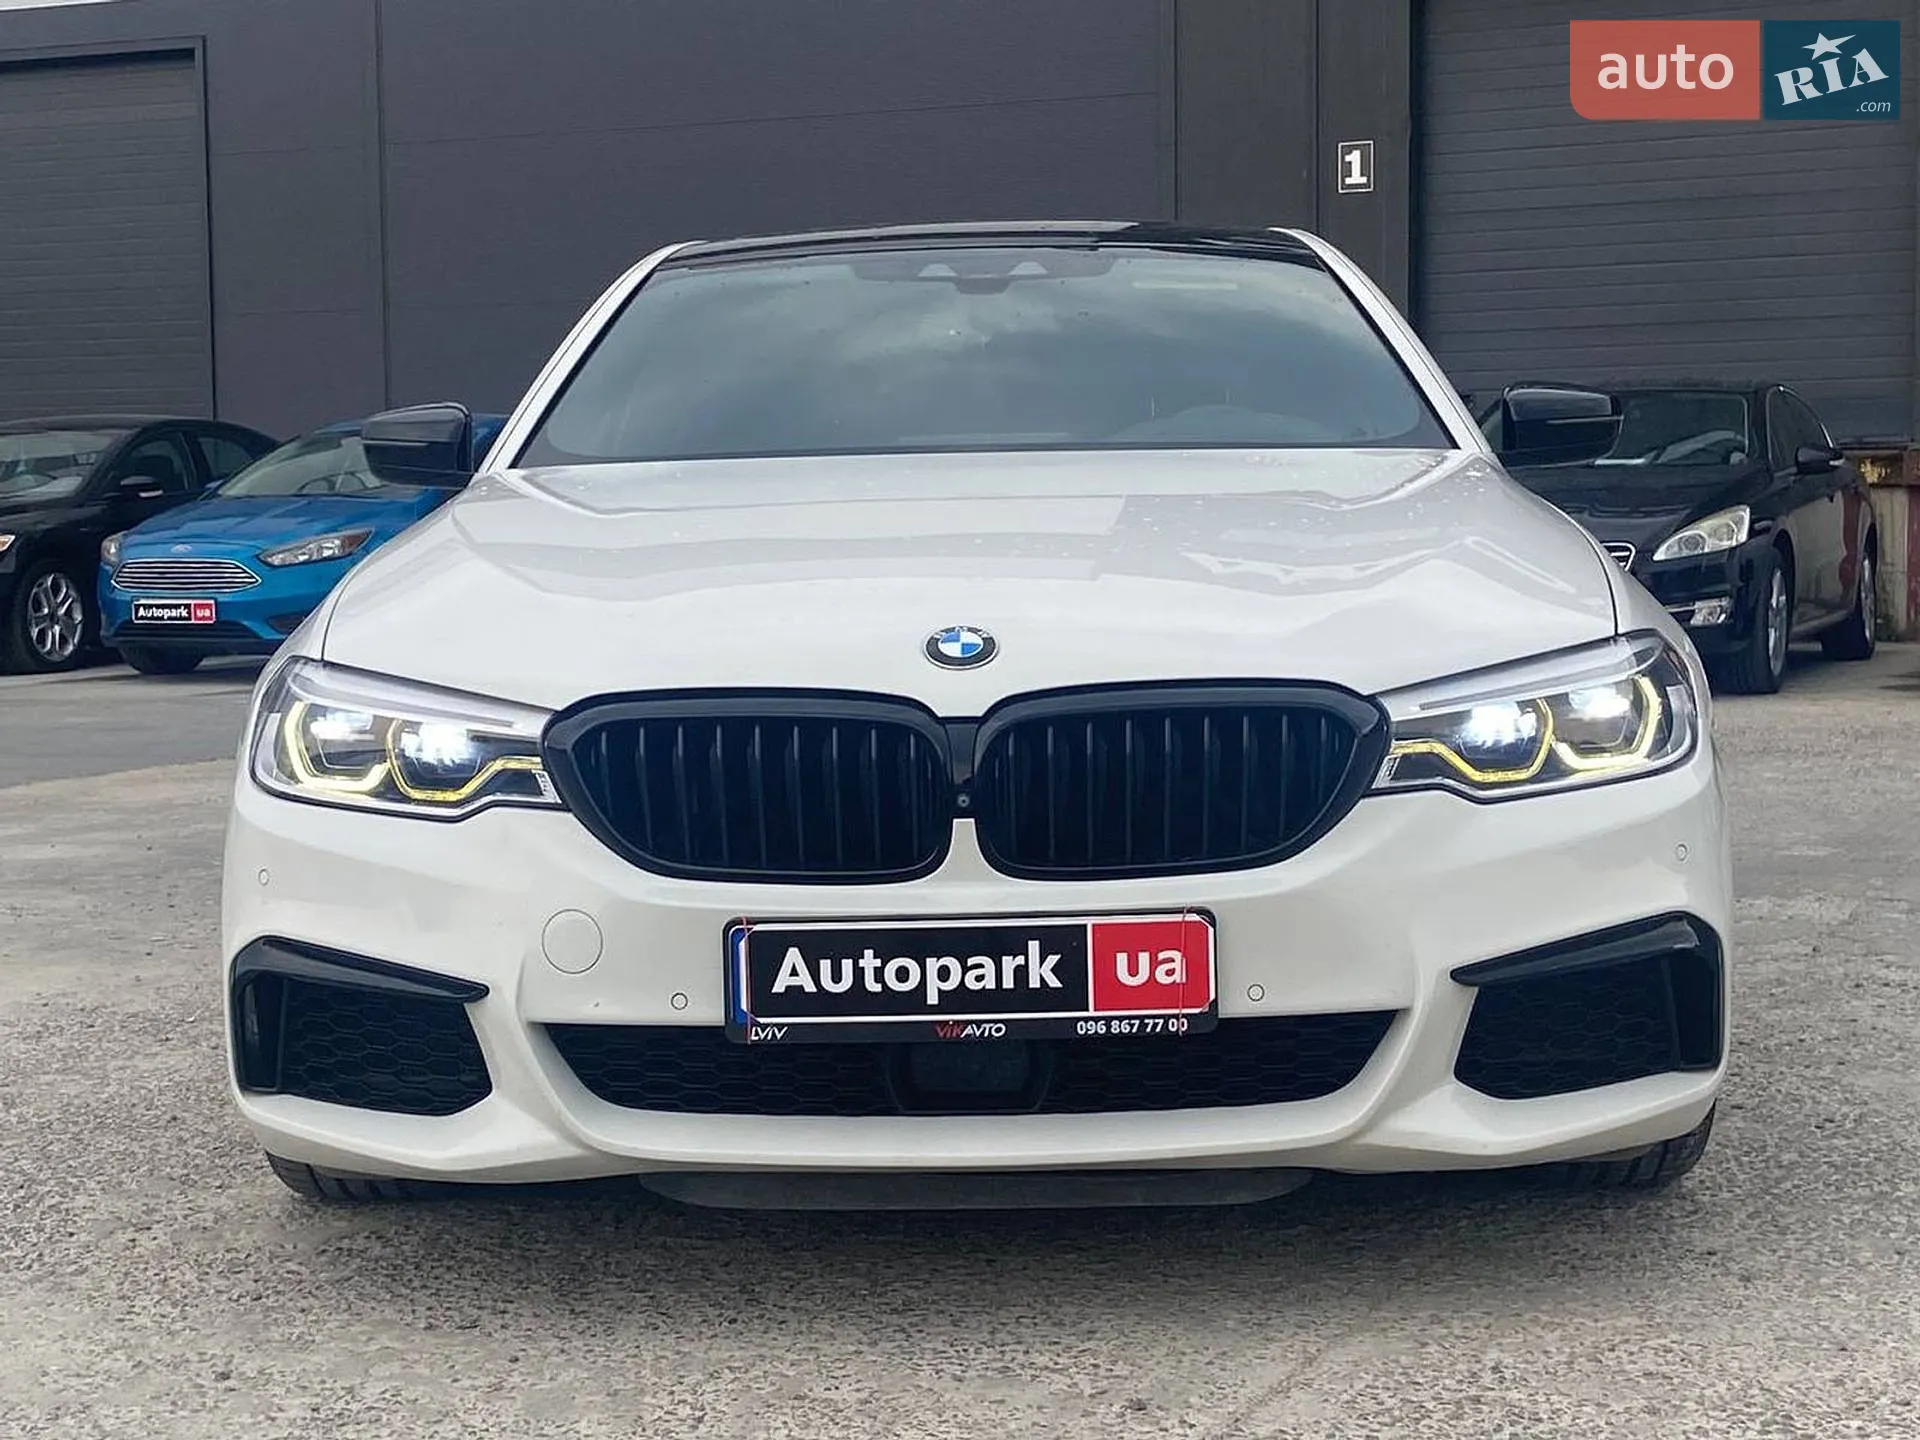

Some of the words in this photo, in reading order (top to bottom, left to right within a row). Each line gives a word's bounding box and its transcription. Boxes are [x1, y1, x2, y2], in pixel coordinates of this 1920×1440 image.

[1344, 149, 1368, 184] 1
[137, 605, 189, 619] Autopark
[196, 608, 211, 617] ua
[771, 940, 1063, 1005] Autopark
[1115, 948, 1188, 986] ua
[1076, 1020, 1107, 1034] 096
[1110, 1020, 1140, 1033] 867
[1144, 1018, 1164, 1032] 77
[1168, 1018, 1188, 1032] 00
